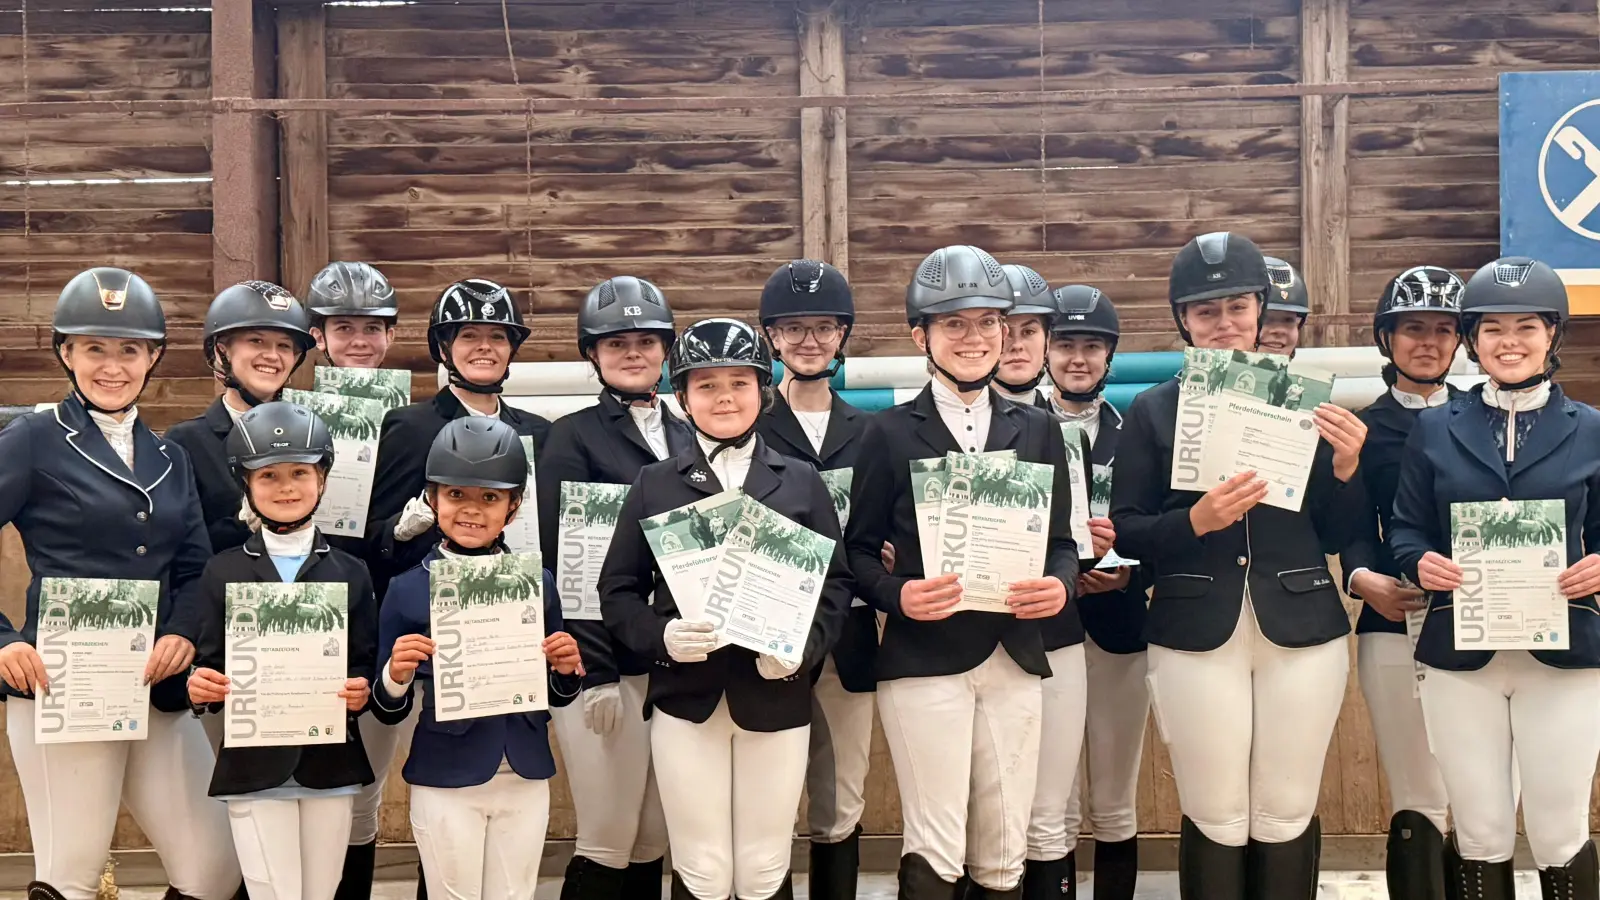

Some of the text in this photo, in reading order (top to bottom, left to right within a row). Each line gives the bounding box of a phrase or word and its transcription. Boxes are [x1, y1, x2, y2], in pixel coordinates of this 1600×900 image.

[623, 305, 642, 316] KB
[1177, 351, 1212, 484] URKUNDE
[1228, 402, 1292, 423] Pferdeführerschein
[562, 485, 588, 613] URKUNDE
[704, 502, 765, 630] URKUNDE
[941, 455, 974, 581] RKUNDE
[1457, 506, 1485, 643] URKUNDE
[41, 583, 72, 733] URKUNDE
[231, 586, 260, 739] URKUNDE
[435, 563, 466, 713] URKUNDE
